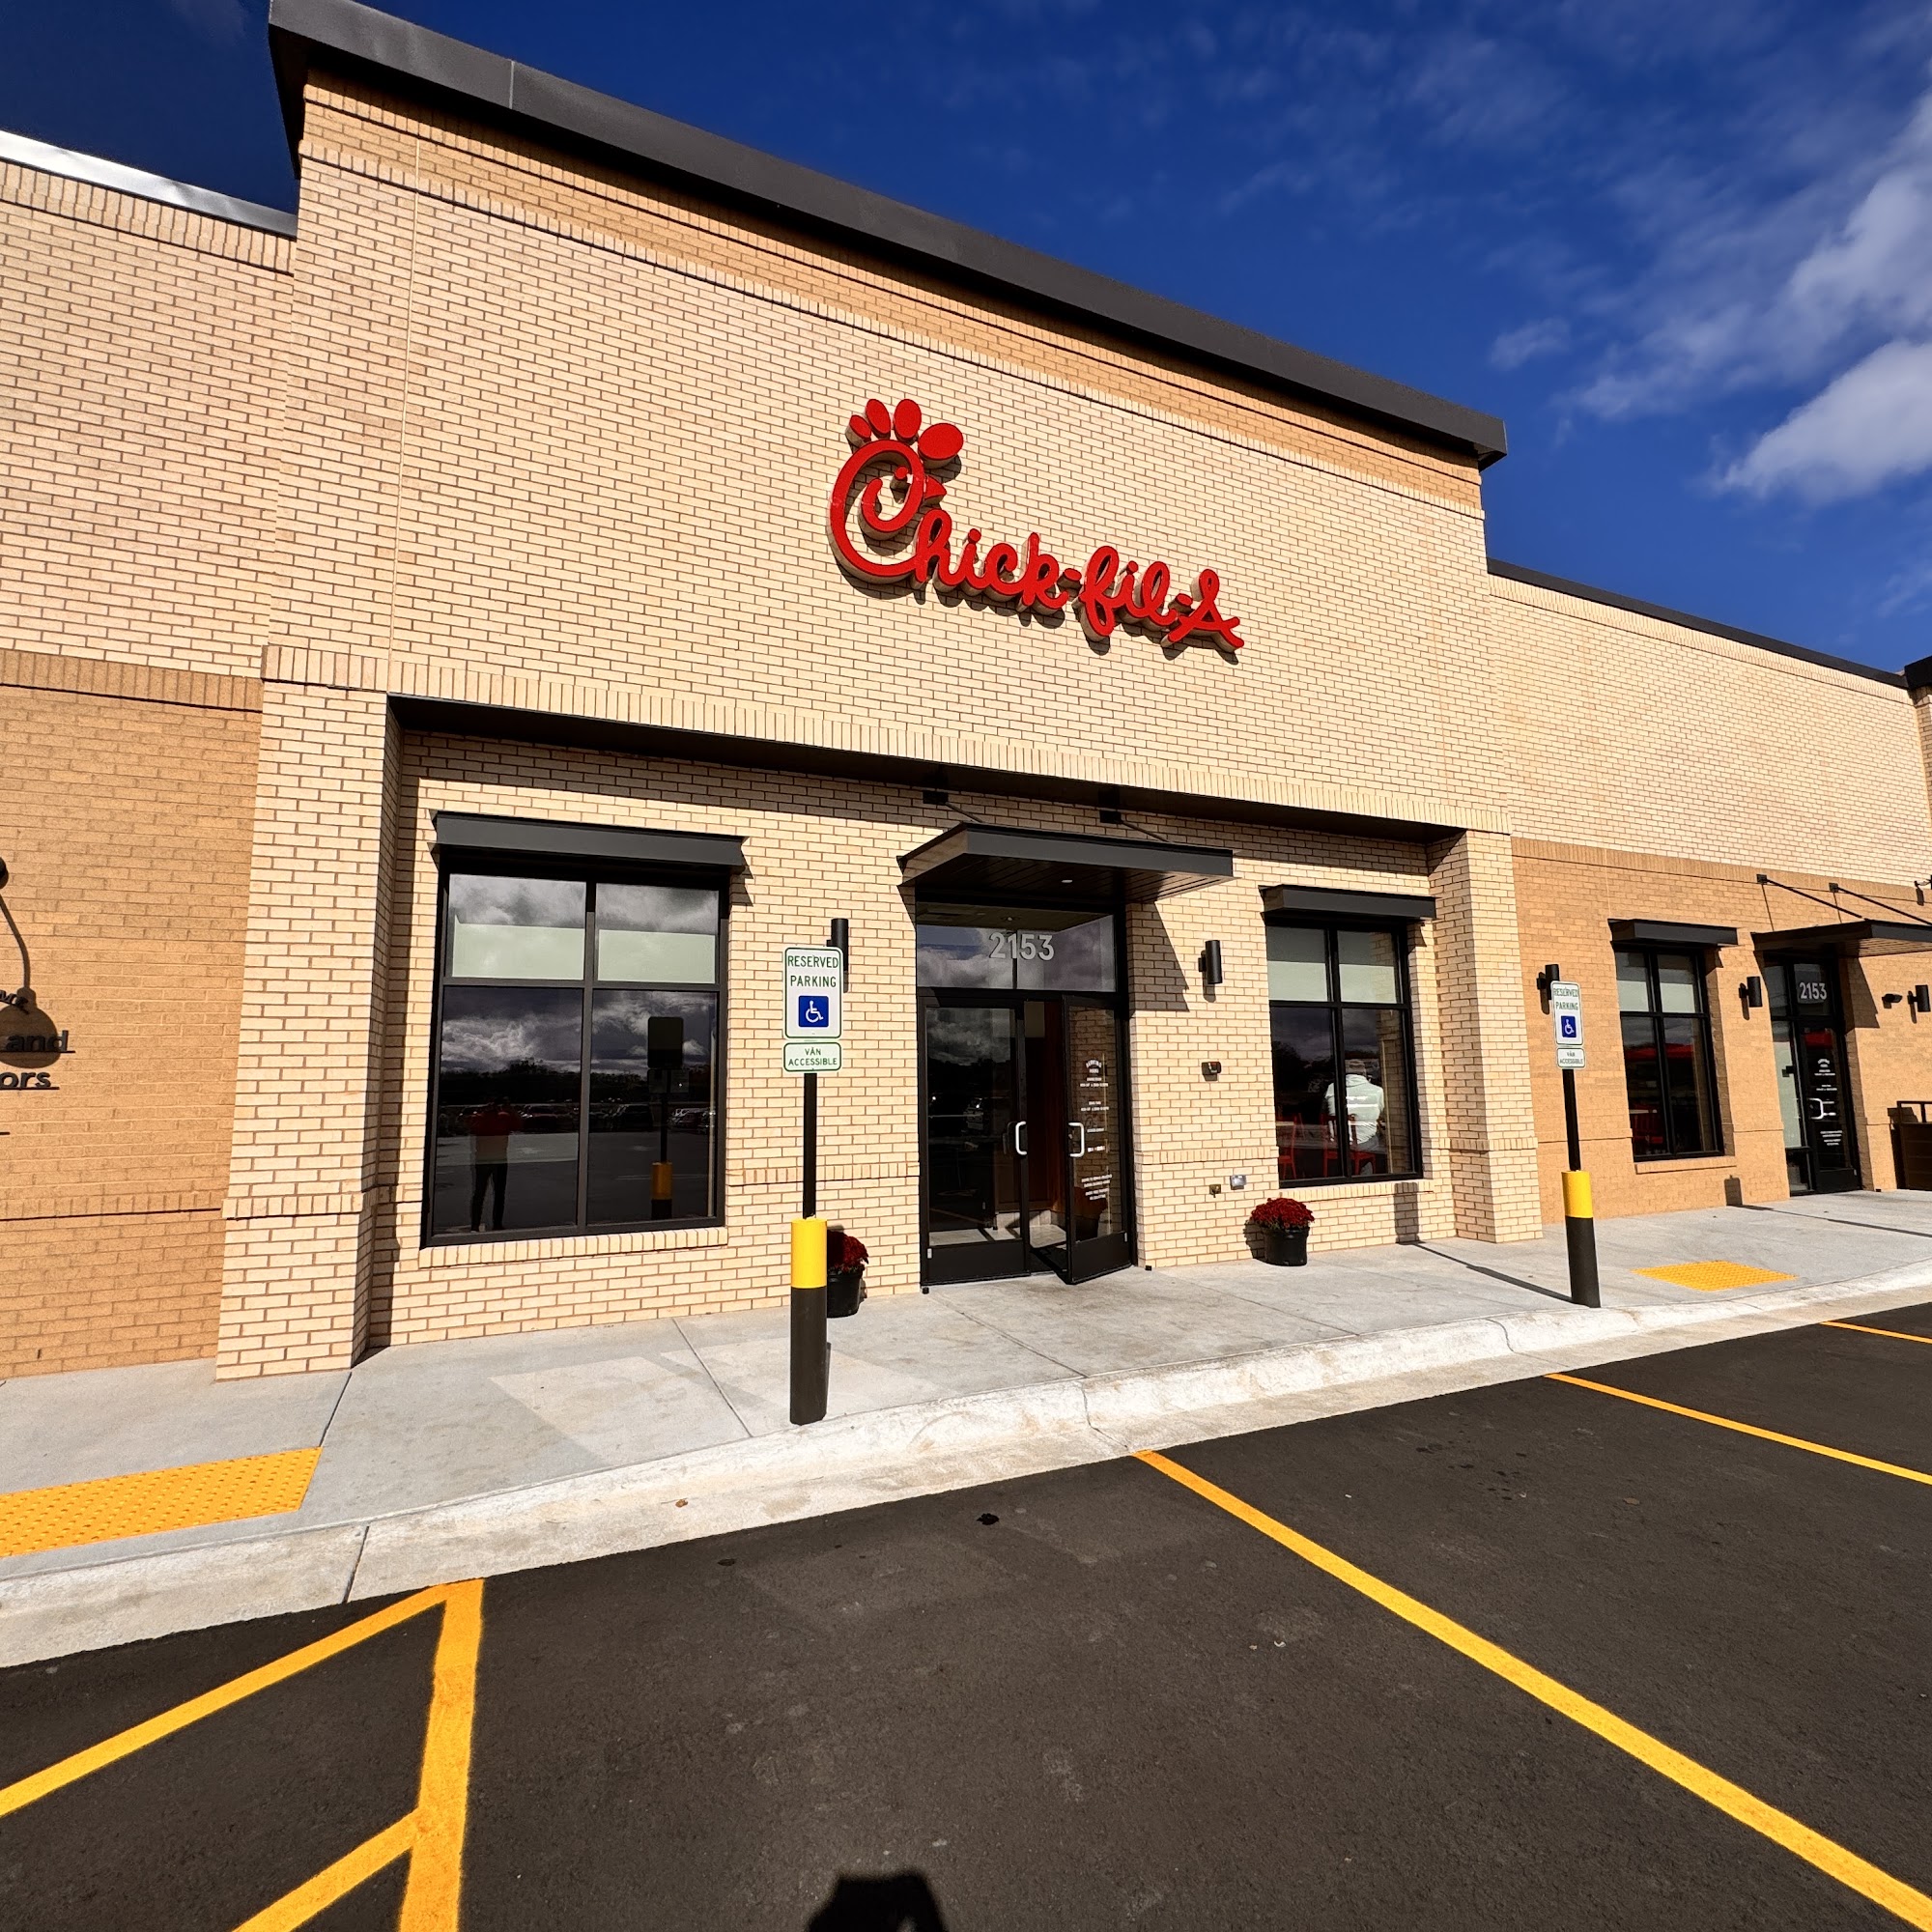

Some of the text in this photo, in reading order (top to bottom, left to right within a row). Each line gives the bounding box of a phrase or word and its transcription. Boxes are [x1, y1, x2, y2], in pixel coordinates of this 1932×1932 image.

[829, 399, 1245, 652] Chick-fil-A
[988, 931, 1055, 961] 2153
[787, 954, 839, 969] RESERVED
[789, 975, 837, 988] PARKING
[1552, 987, 1579, 998] RESERVED
[1799, 981, 1828, 1001] 2153
[1555, 1001, 1579, 1010] PARKING
[6, 1030, 70, 1052] and
[804, 1047, 822, 1057] VAN
[787, 1057, 838, 1066] ACCESSIBLE
